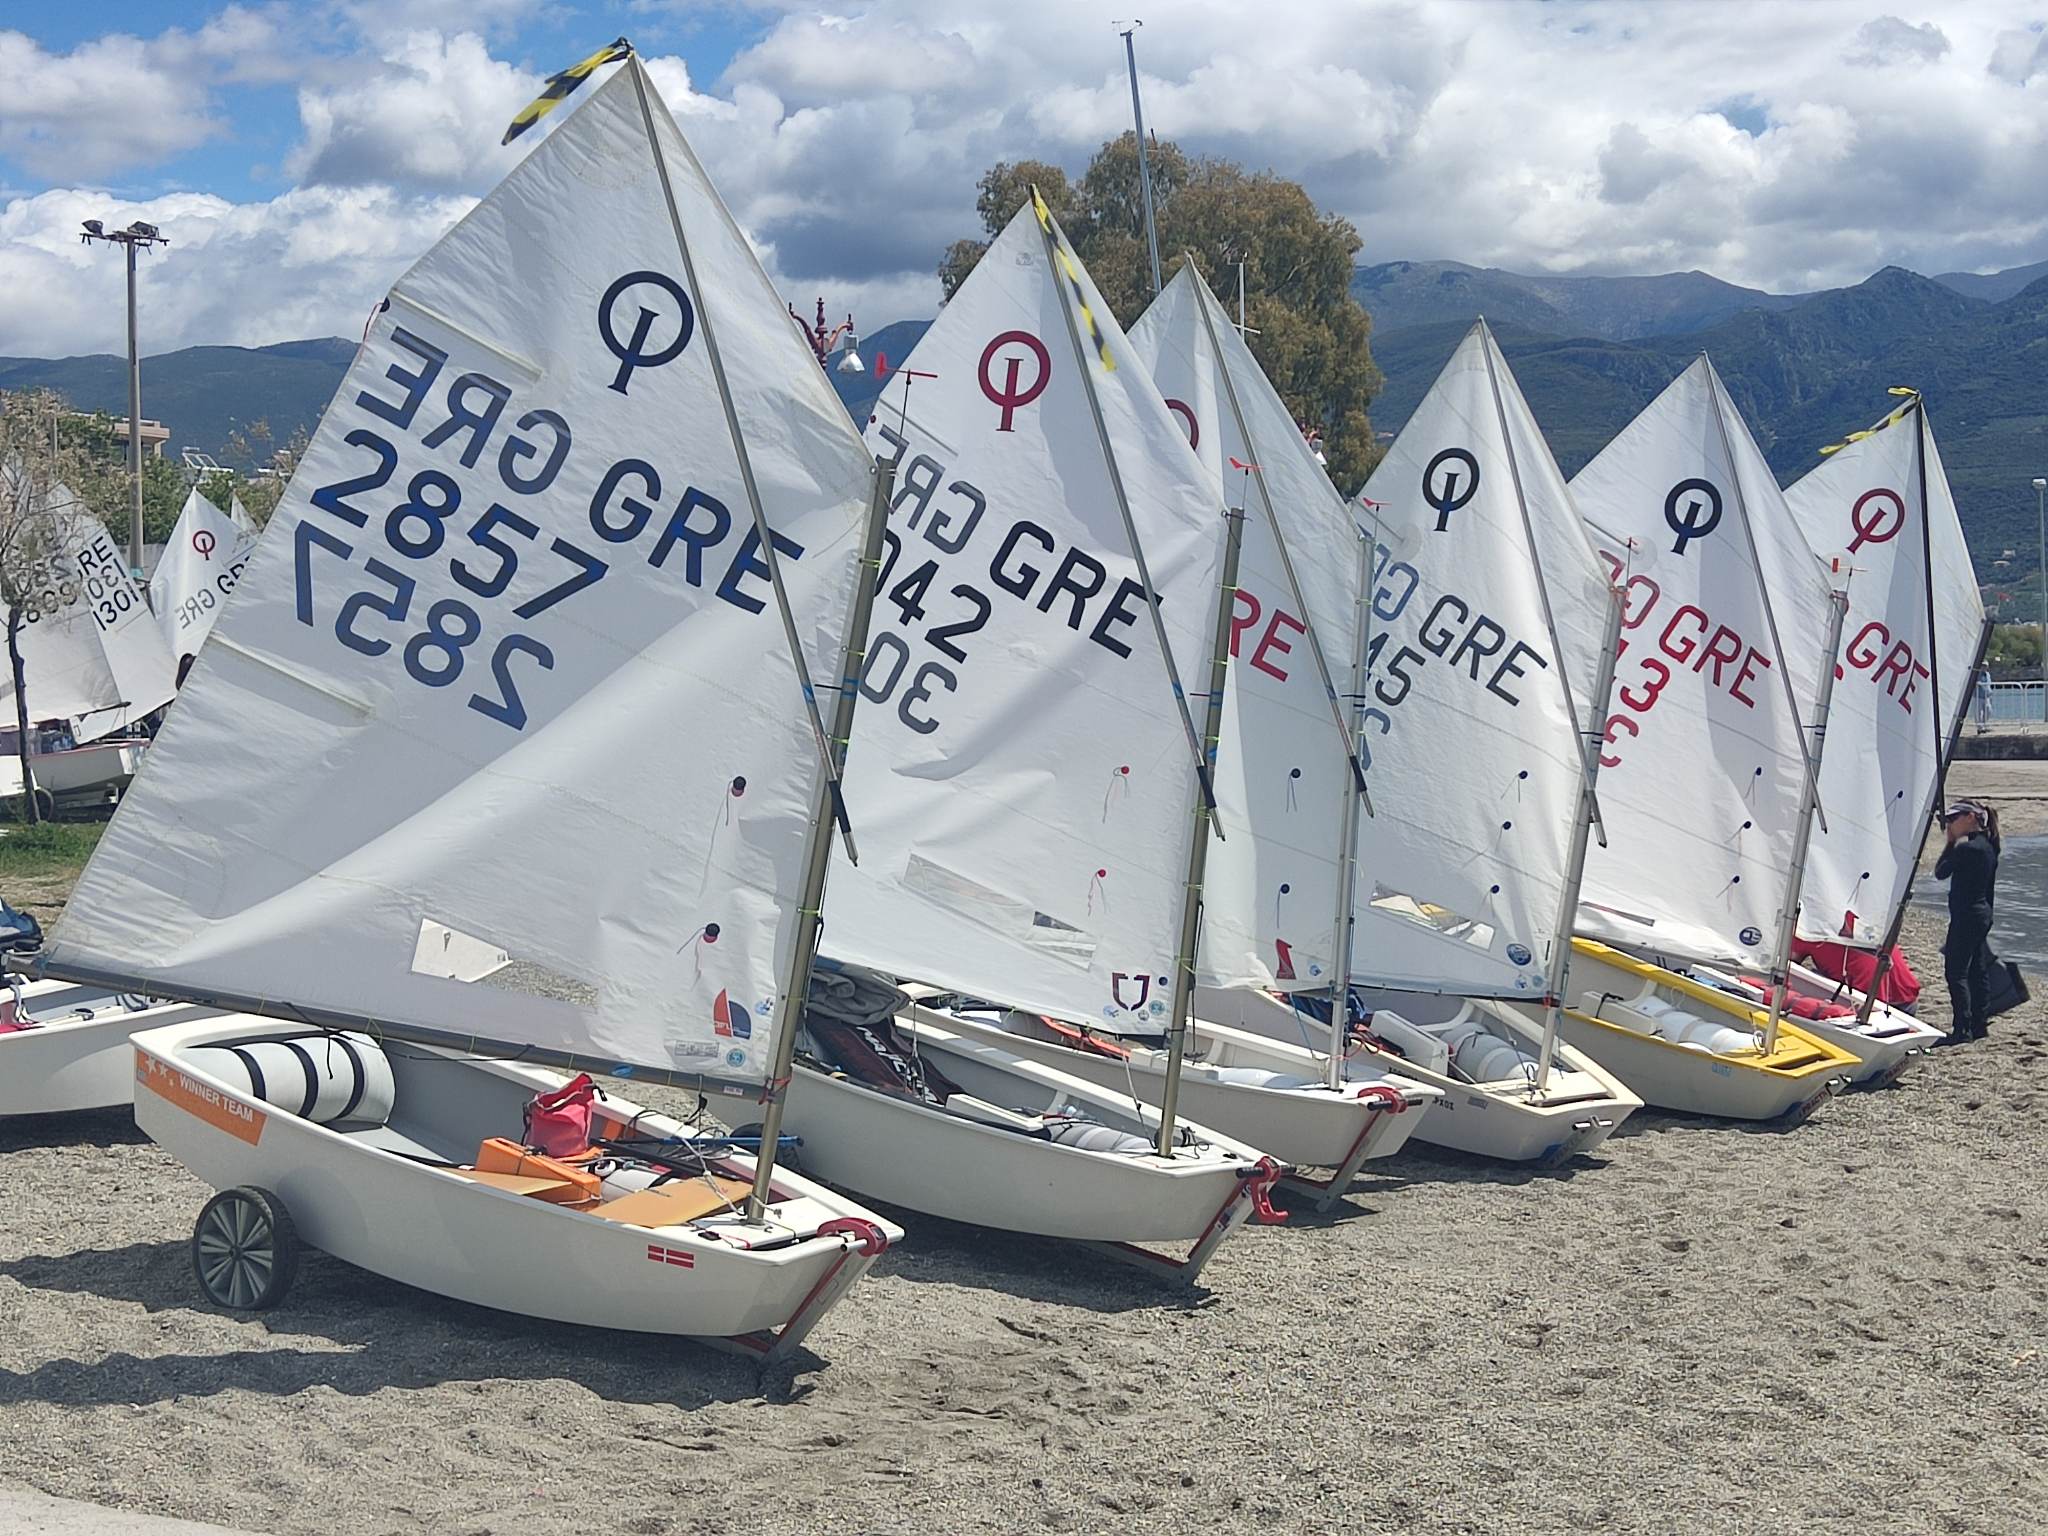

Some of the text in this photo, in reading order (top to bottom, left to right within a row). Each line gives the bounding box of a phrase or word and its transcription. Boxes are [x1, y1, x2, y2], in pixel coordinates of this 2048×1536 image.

[76, 536, 112, 580] RE
[310, 429, 609, 620] 2857
[588, 458, 804, 615] GRE
[990, 520, 1164, 660] GRE
[1418, 594, 1548, 707] GRE
[1658, 604, 1771, 709] GRE
[1845, 621, 1930, 715] GRE
[179, 1072, 254, 1122] WINNER TEAM
